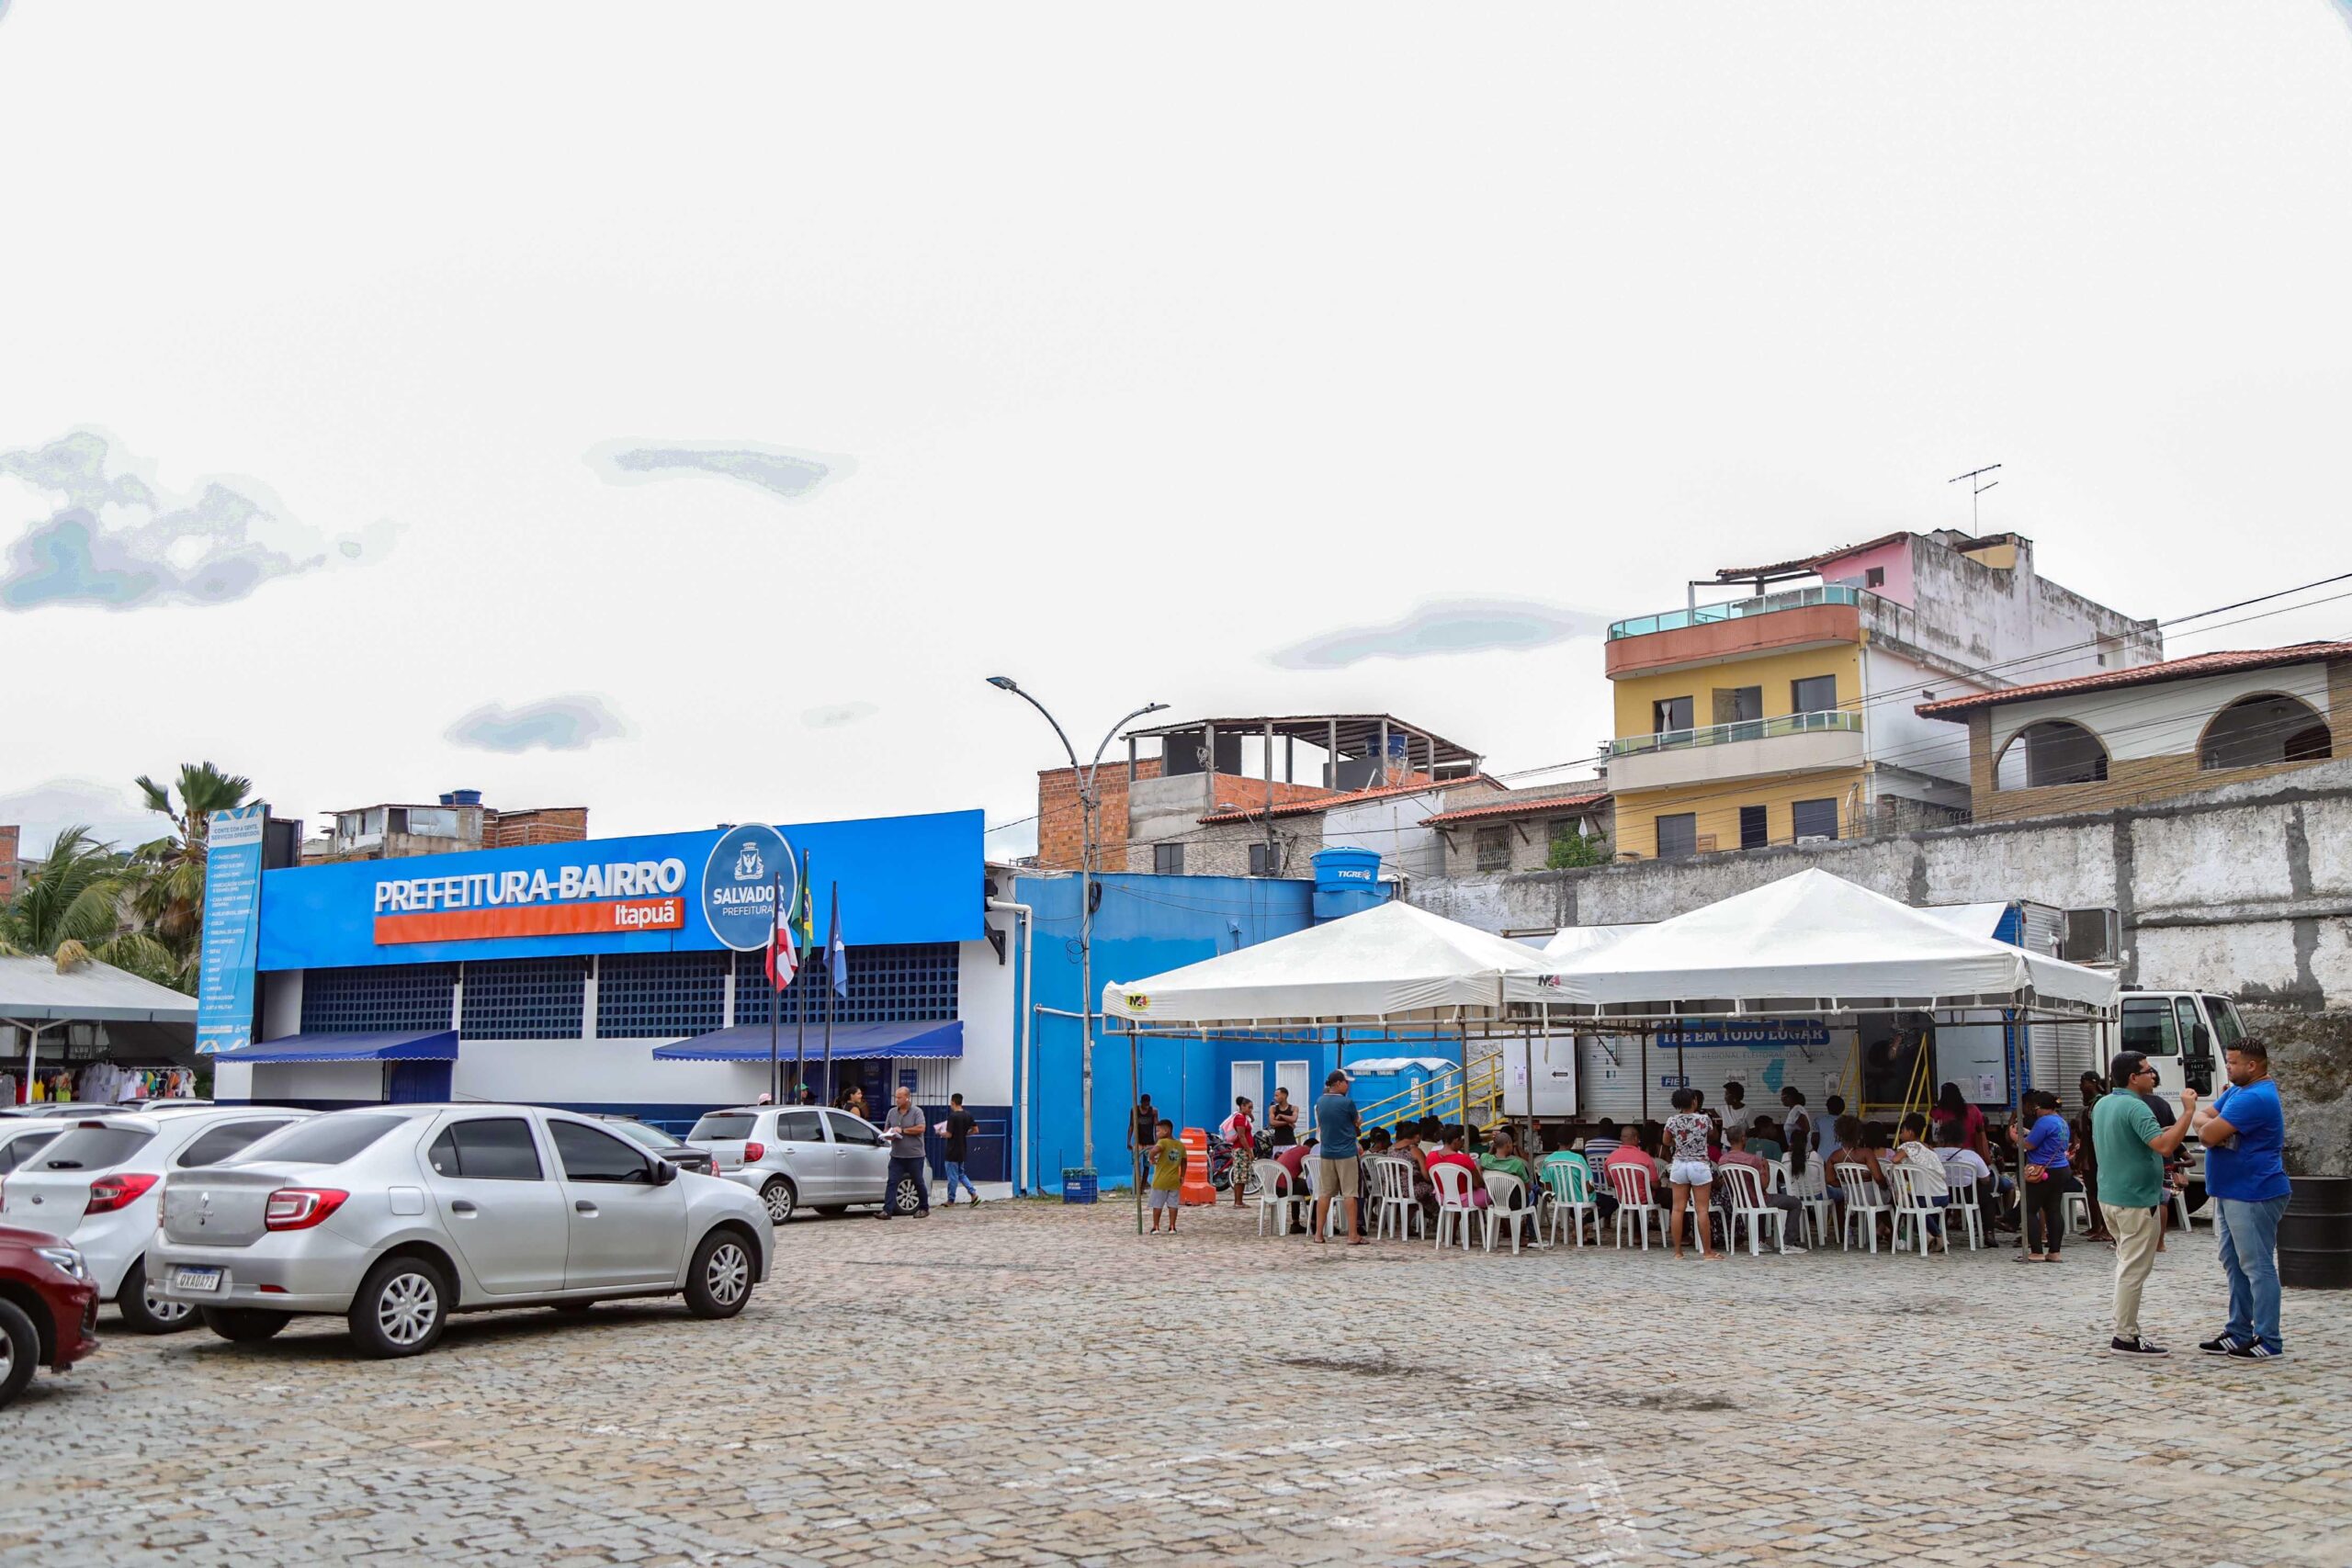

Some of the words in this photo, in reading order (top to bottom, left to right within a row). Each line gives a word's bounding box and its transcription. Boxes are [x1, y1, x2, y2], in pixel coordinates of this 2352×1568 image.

[1338, 870, 1363, 879] TIGRE
[375, 857, 685, 912] PREFEITURA-BAIRRO
[615, 899, 675, 929] Itapuã
[722, 904, 774, 916] PREFEITURA
[1695, 1031, 1718, 1042] EM
